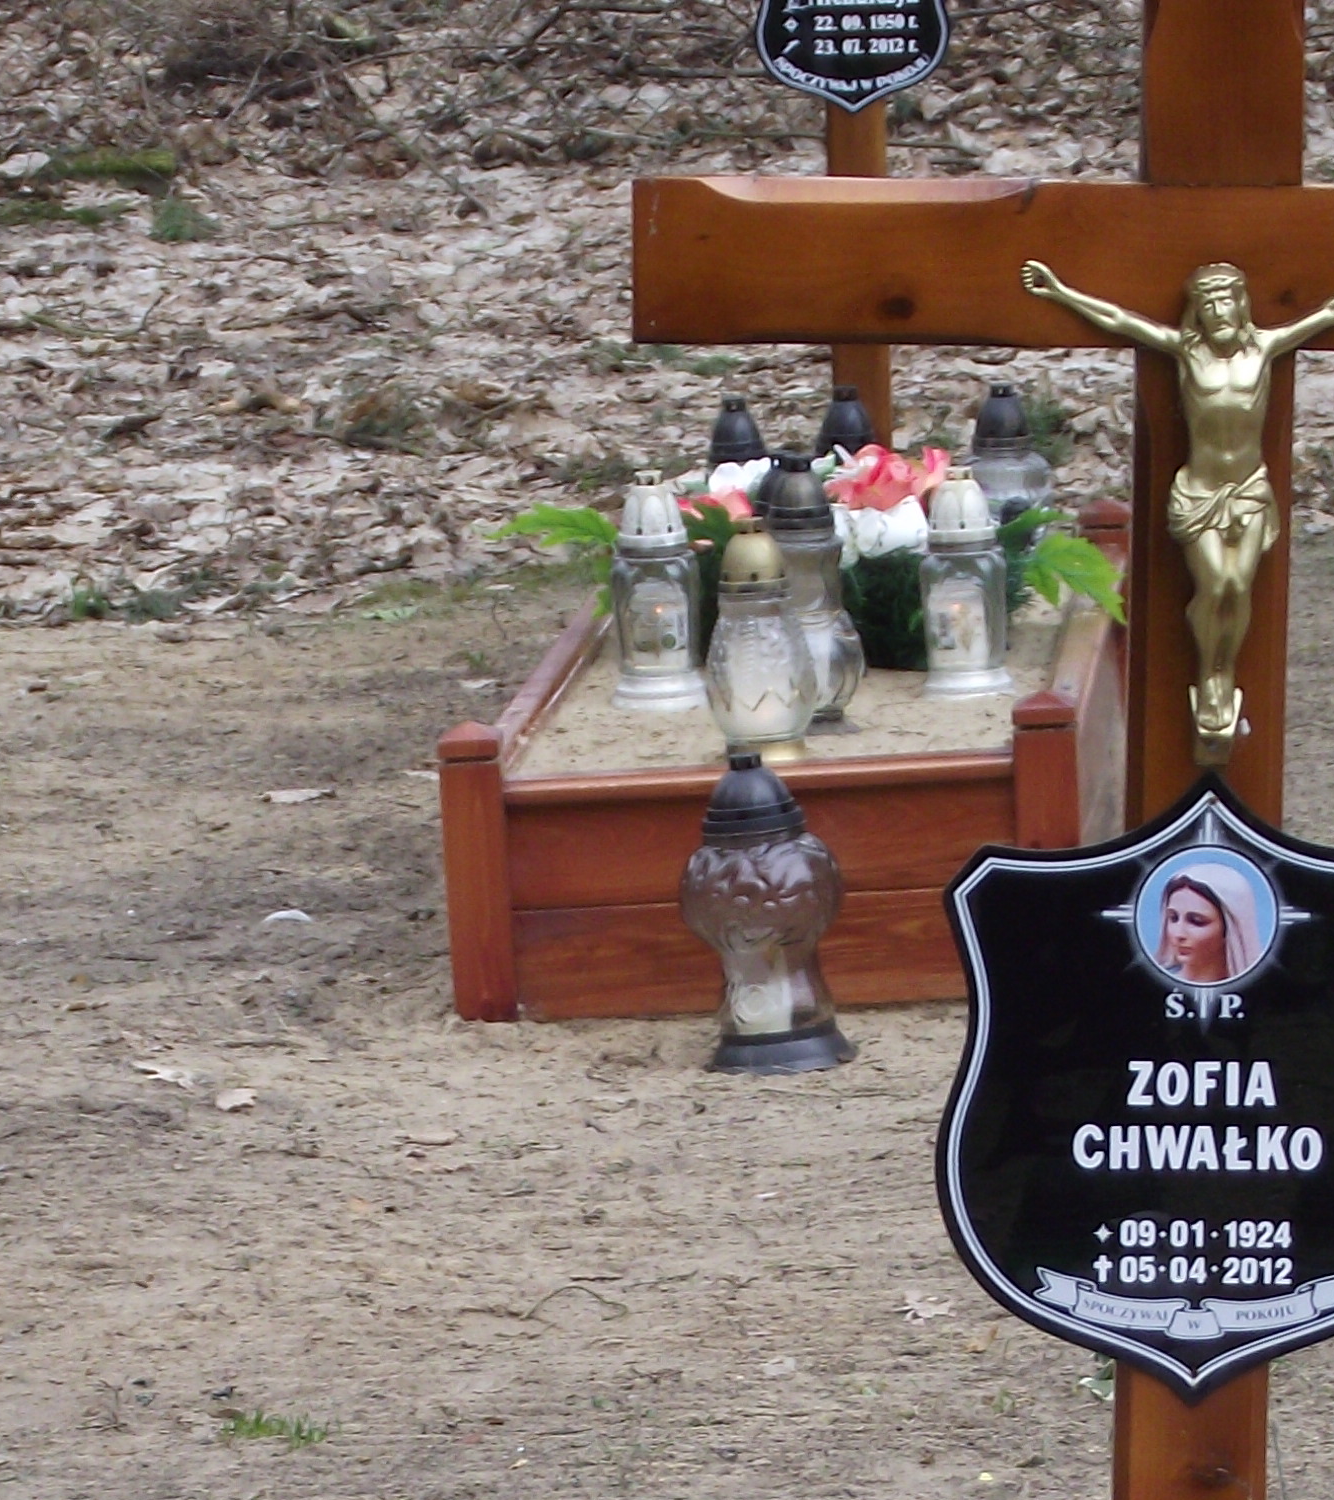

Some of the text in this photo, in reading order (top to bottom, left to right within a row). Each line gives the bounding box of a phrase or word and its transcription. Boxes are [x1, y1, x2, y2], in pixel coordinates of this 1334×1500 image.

[868, 37, 905, 53] 2012
[1218, 992, 1245, 1018] P.
[1126, 1060, 1278, 1106] ZOFIA
[1072, 1123, 1324, 1171] CHWAŁKO
[1187, 1318, 1202, 1331] W
[1234, 1303, 1298, 1321] POKOJU
